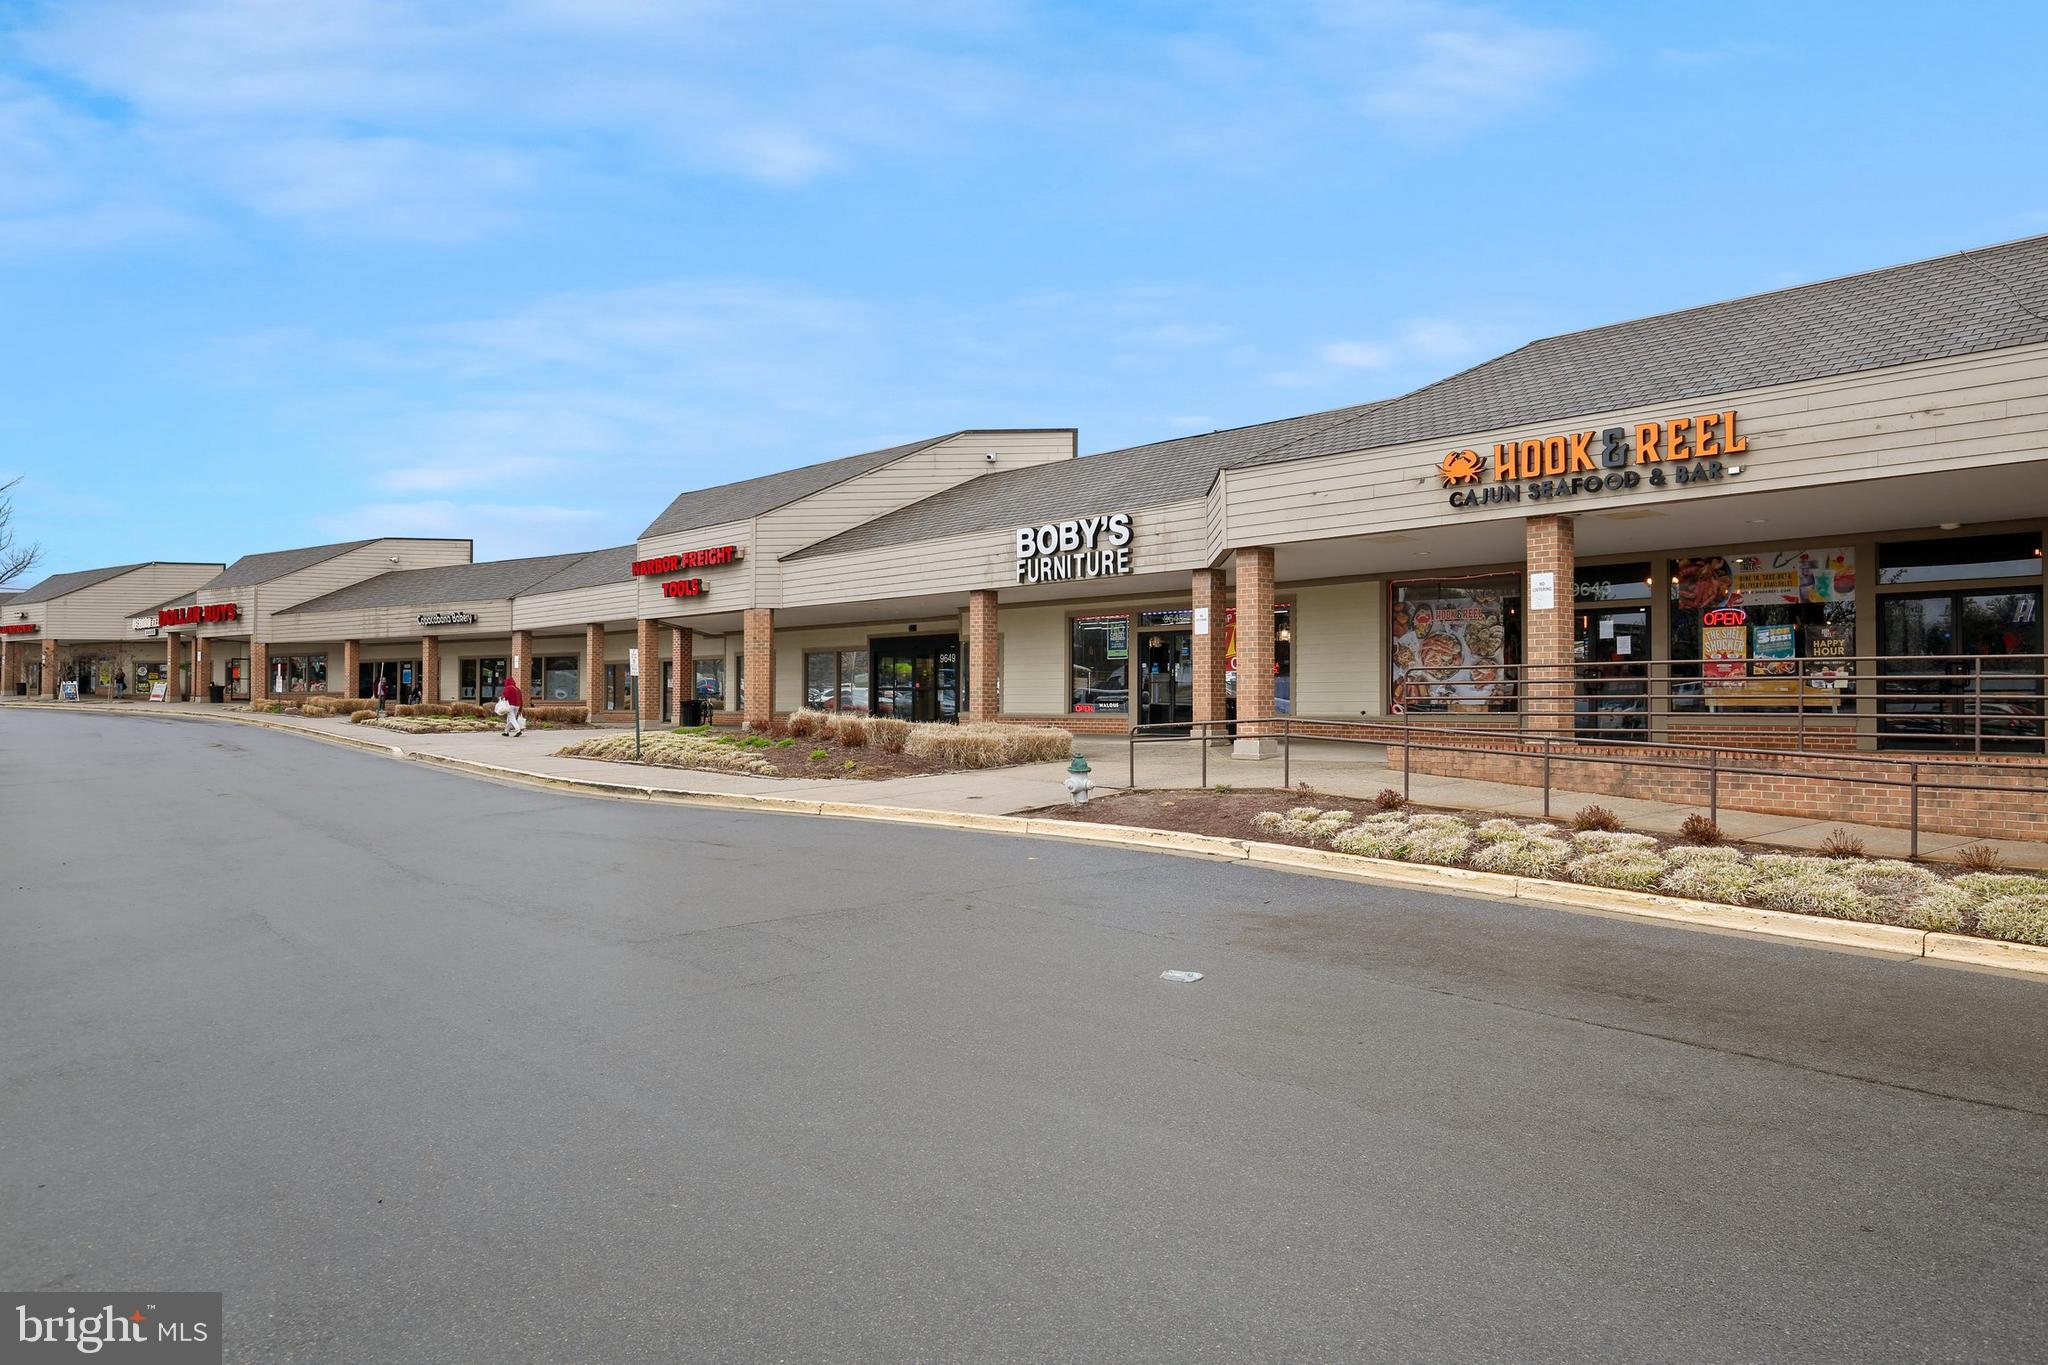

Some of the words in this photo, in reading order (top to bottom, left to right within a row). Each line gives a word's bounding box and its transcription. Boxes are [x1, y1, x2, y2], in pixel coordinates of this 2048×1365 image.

[1494, 431, 1596, 481] HOOK
[1601, 427, 1629, 468] &
[1633, 410, 1748, 465] REEL
[1449, 484, 1521, 508] CAJUN
[1528, 470, 1640, 501] SEAFOOD
[1648, 468, 1666, 487] &
[1675, 462, 1722, 484] BAR
[1016, 513, 1132, 559] BOBY'S
[631, 555, 678, 577] HARBOR
[681, 546, 735, 569] FREIGHT
[1016, 547, 1132, 584] FURNITURE
[662, 578, 700, 598] TOOLS
[158, 606, 202, 627] DOLLAR
[203, 603, 237, 623] BUYS
[417, 614, 451, 625] Copacabana
[451, 611, 472, 624] Bakery
[1703, 612, 1743, 626] OPEN
[1706, 629, 1721, 641] THE
[1721, 628, 1744, 641] SHELL
[1705, 638, 1744, 653] SHOCKER
[1813, 639, 1845, 648] HAPPY
[1813, 646, 1844, 656] HOUR
[940, 653, 956, 664] 9649
[1075, 703, 1094, 712] OPEN
